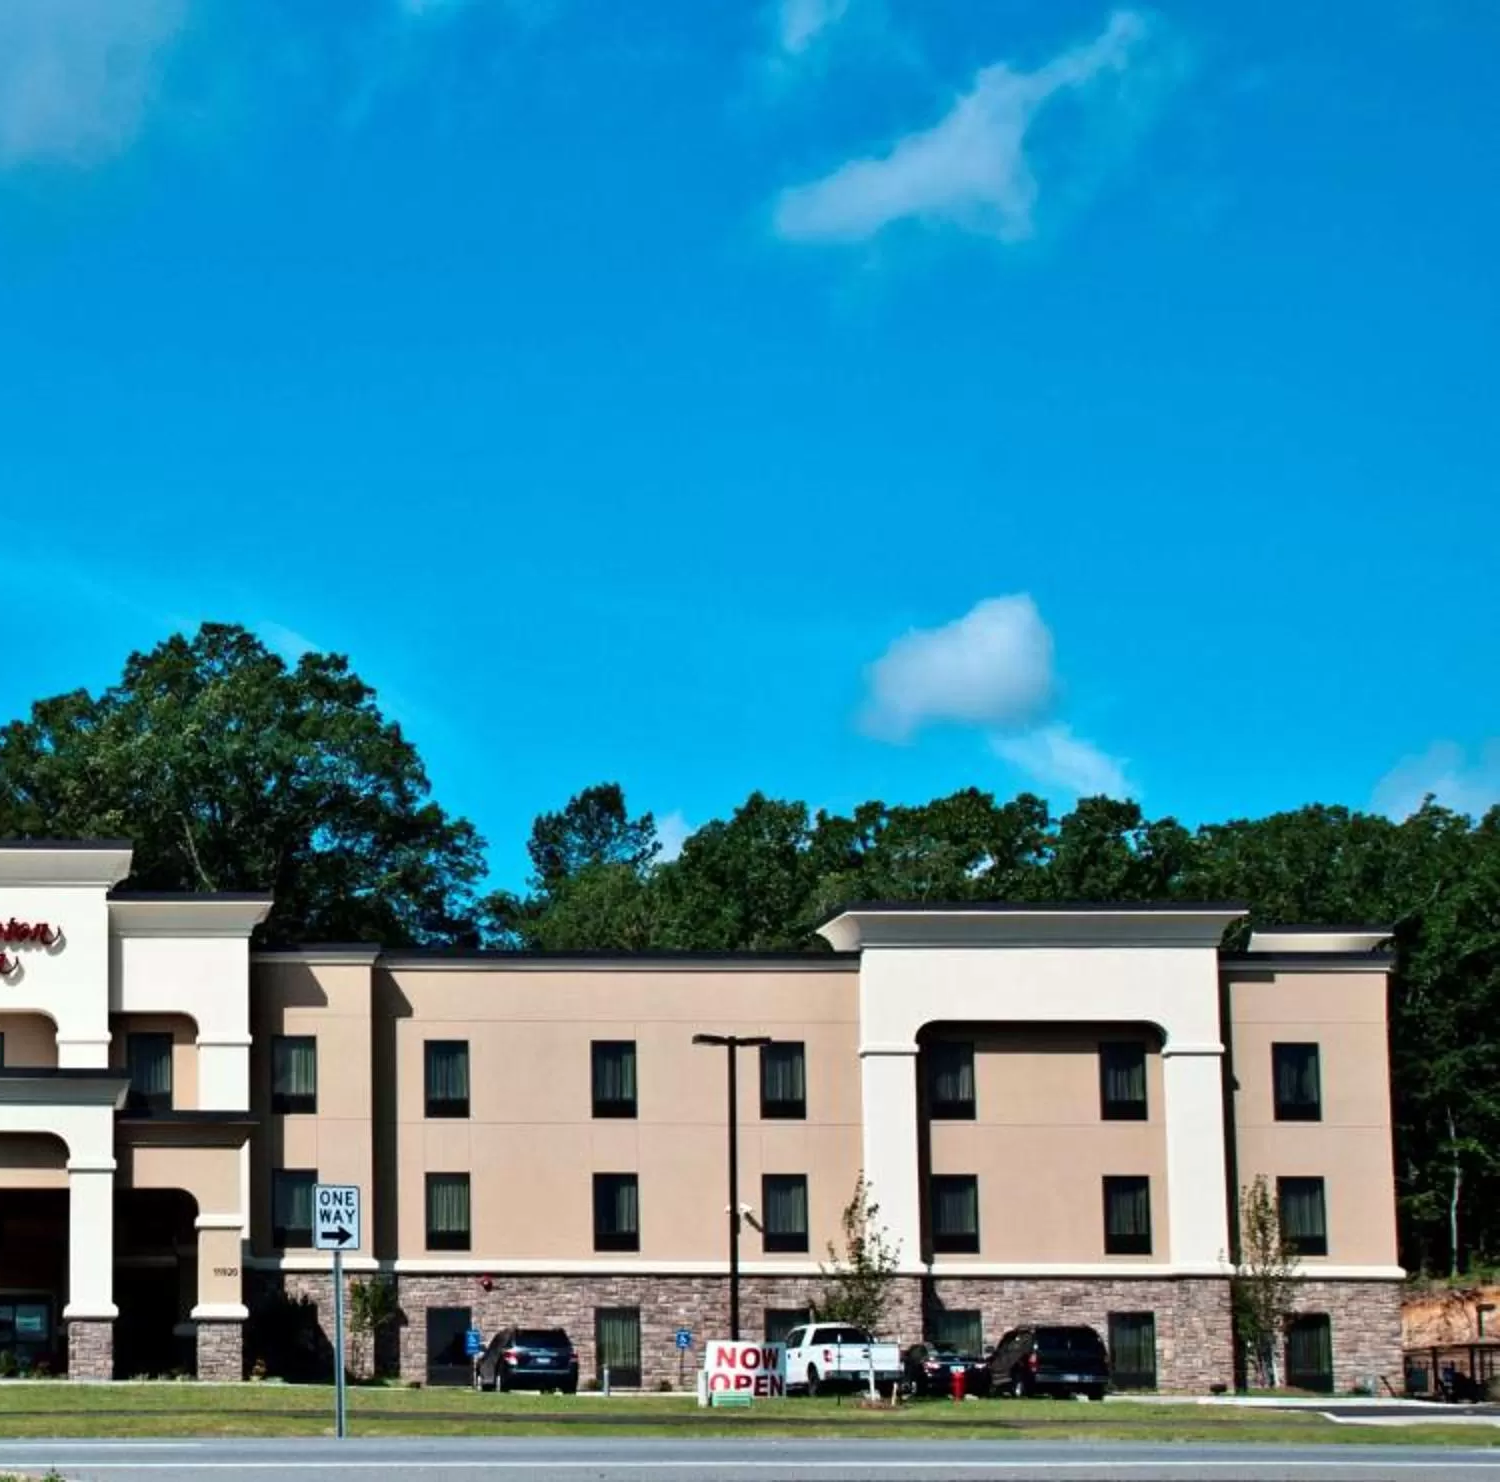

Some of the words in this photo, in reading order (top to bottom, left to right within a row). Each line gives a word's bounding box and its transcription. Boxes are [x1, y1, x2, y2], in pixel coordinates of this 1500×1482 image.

[320, 1191, 354, 1206] ONE
[320, 1209, 355, 1224] WAY
[716, 1346, 779, 1370] NOW
[709, 1373, 784, 1397] OPEN
